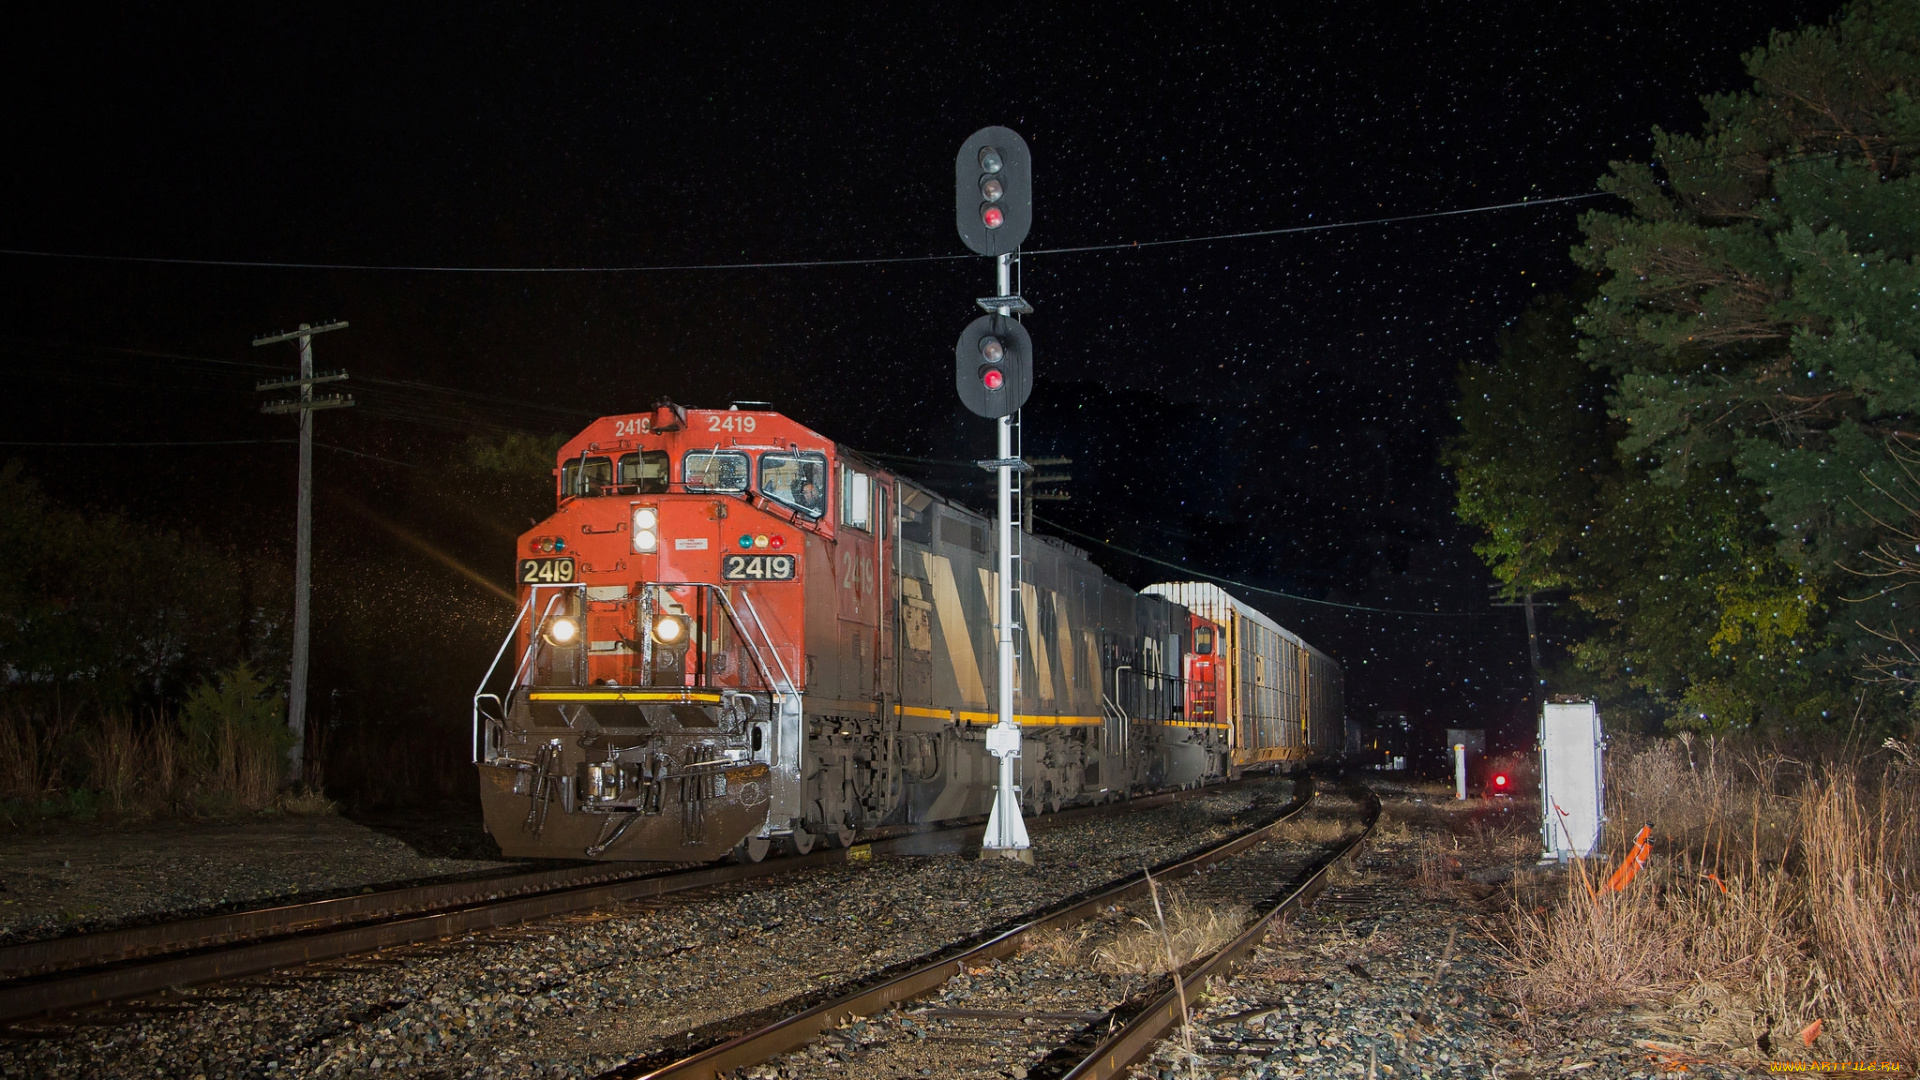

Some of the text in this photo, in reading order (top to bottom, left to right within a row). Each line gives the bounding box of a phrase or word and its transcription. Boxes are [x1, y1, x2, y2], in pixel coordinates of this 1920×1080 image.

[615, 417, 651, 437] 2419
[708, 415, 756, 433] 2419
[523, 560, 574, 582] 2419
[729, 556, 790, 579] 2419
[843, 551, 874, 595] 2419
[1143, 636, 1164, 691] CN
